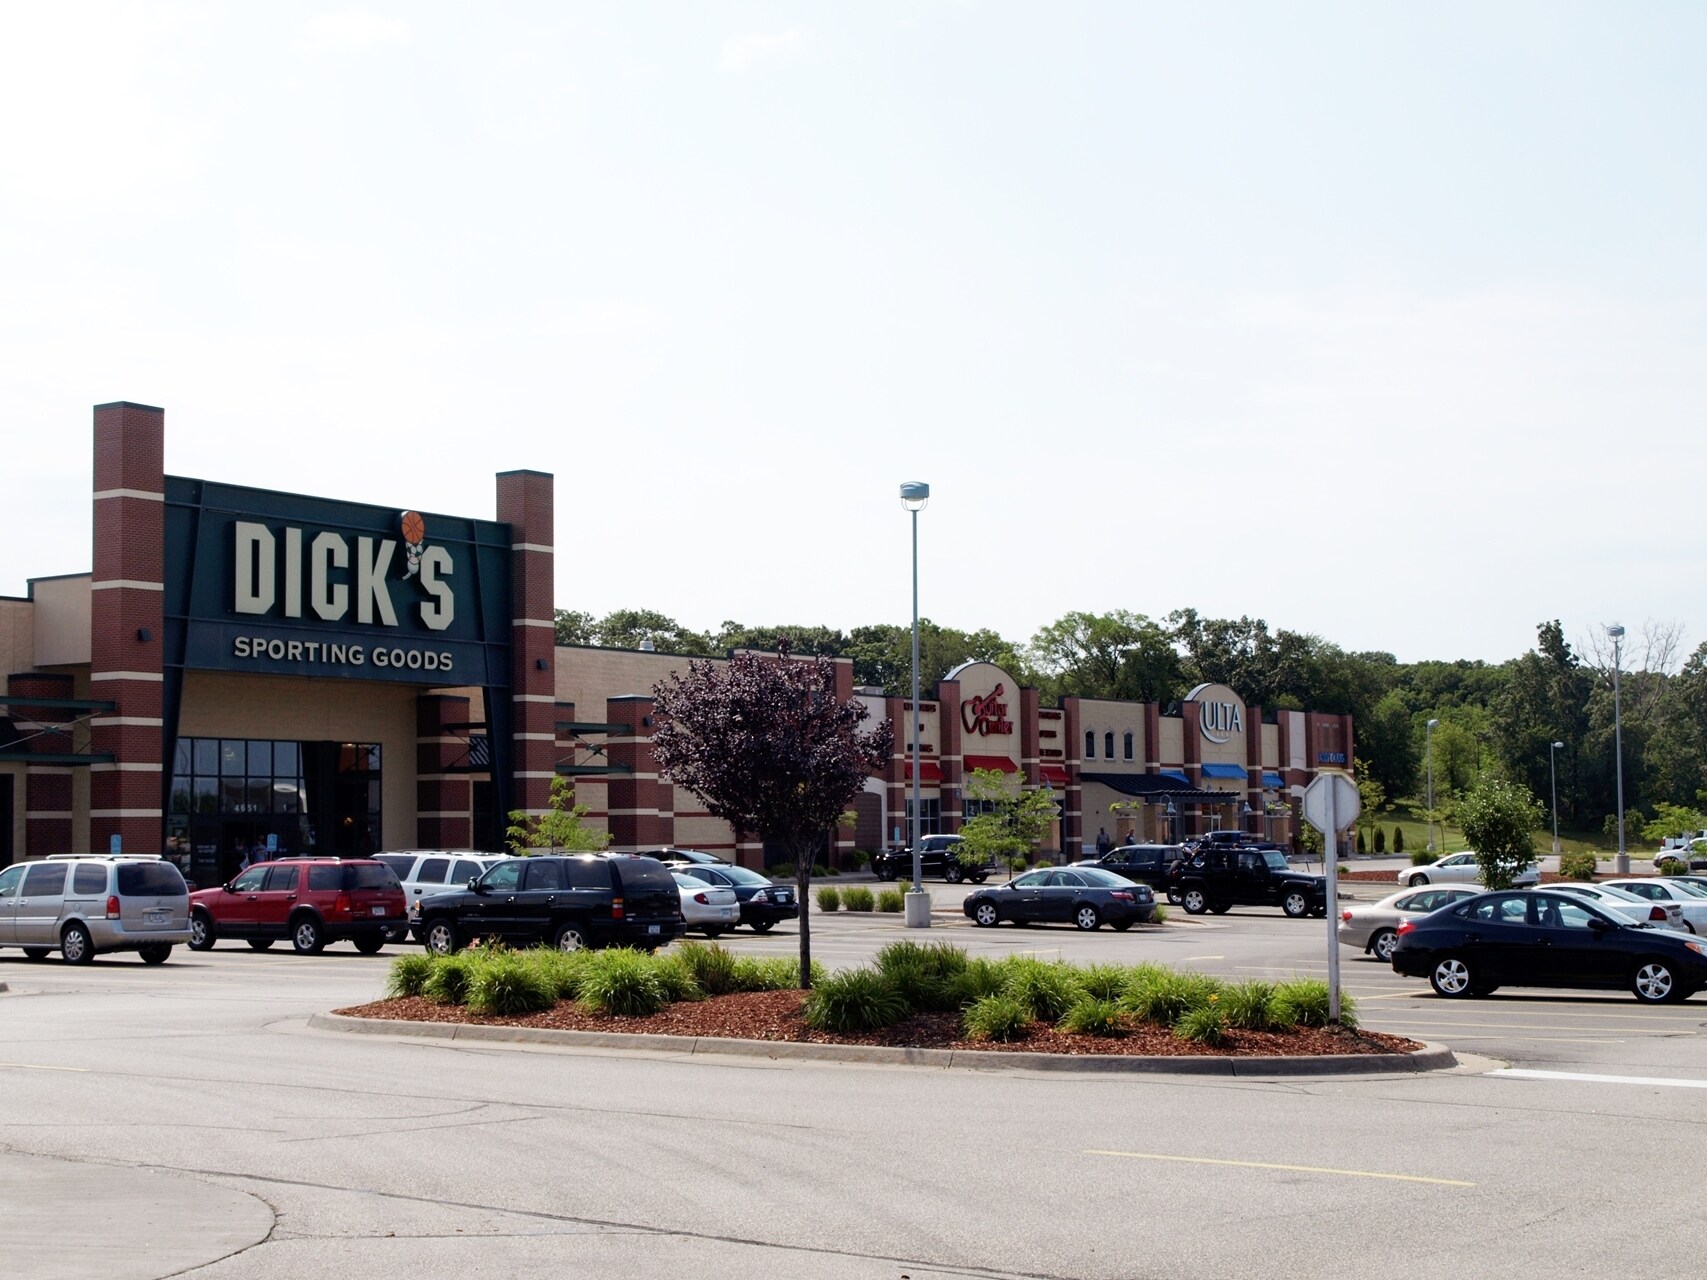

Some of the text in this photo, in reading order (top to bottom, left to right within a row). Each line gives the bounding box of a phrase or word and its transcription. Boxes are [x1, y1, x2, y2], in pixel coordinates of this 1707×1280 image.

[235, 512, 454, 630] DICK'S
[235, 636, 453, 671] SPORTING GOODS
[1203, 701, 1242, 732] ULTA
